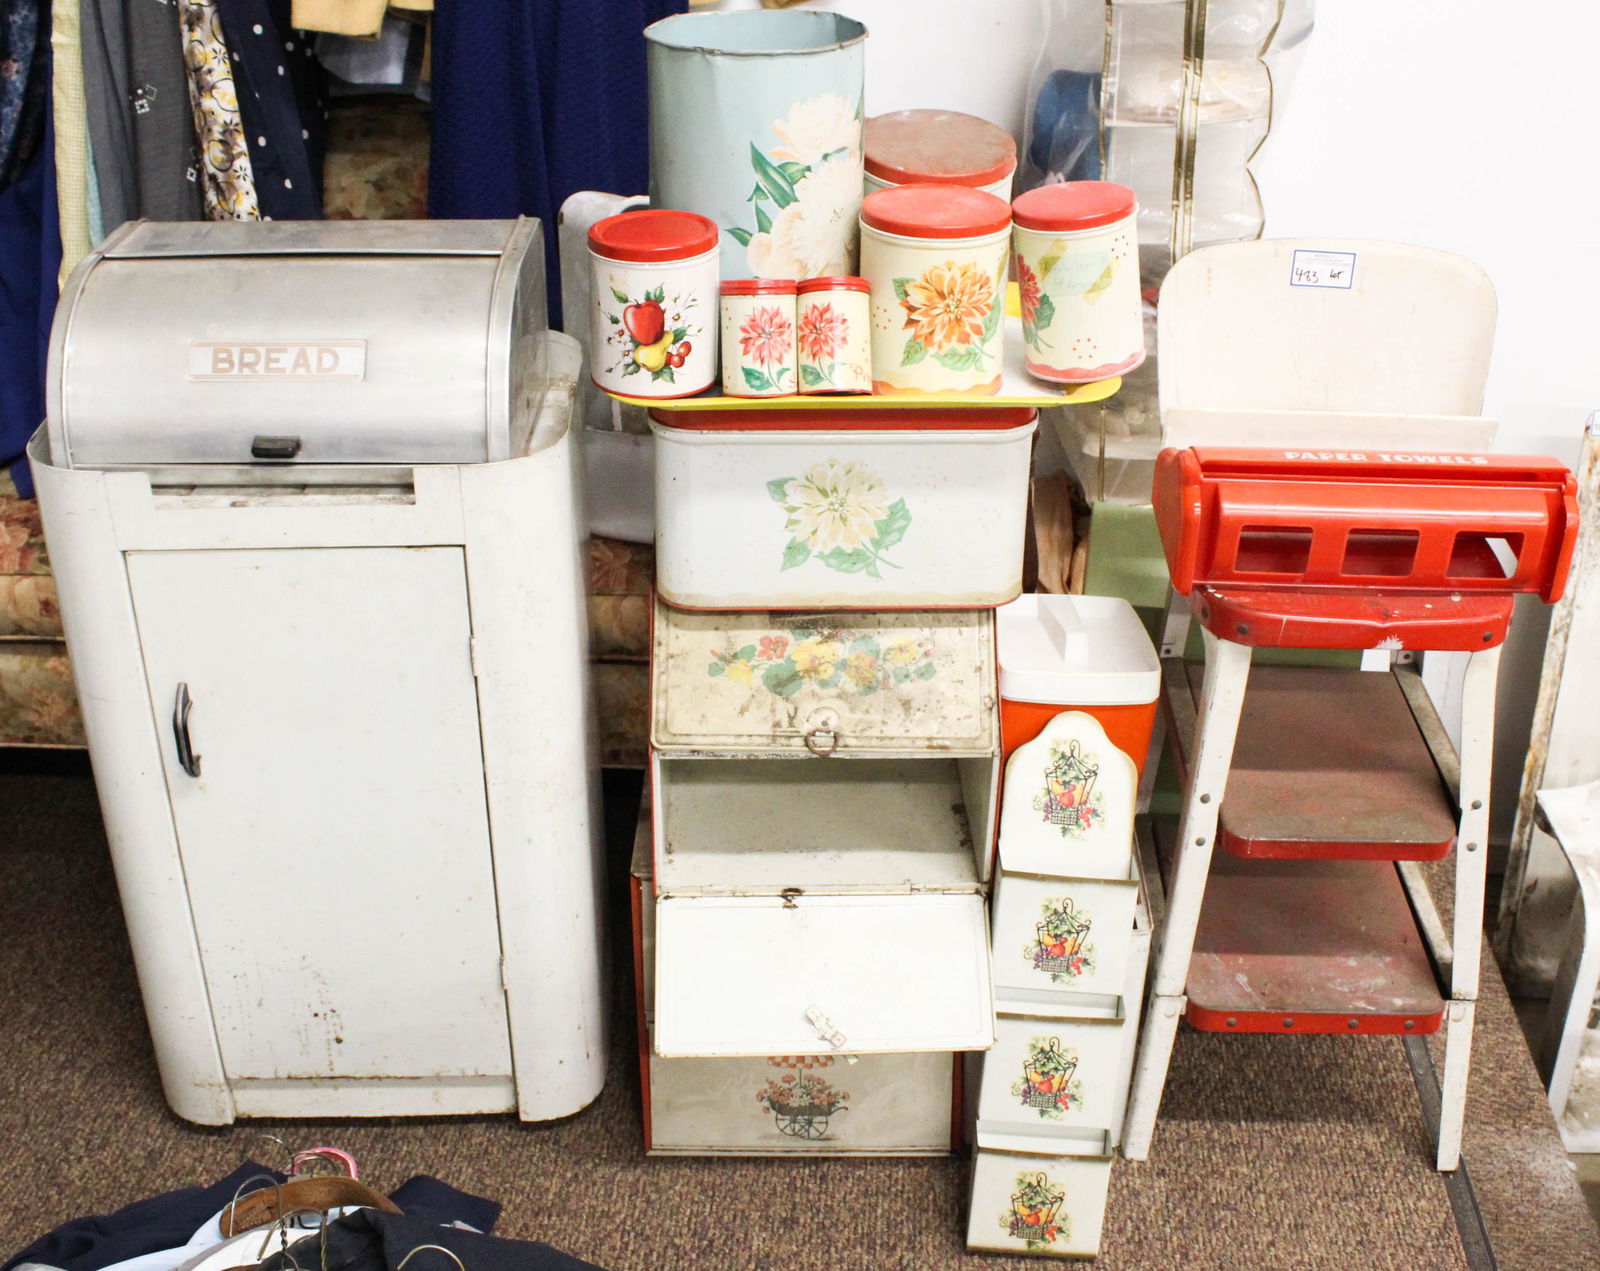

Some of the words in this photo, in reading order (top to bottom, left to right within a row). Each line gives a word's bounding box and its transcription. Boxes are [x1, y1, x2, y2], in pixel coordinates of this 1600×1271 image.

[211, 347, 341, 375] BREAD
[1283, 451, 1368, 463] PAPER
[1376, 453, 1489, 465] TOWELS
